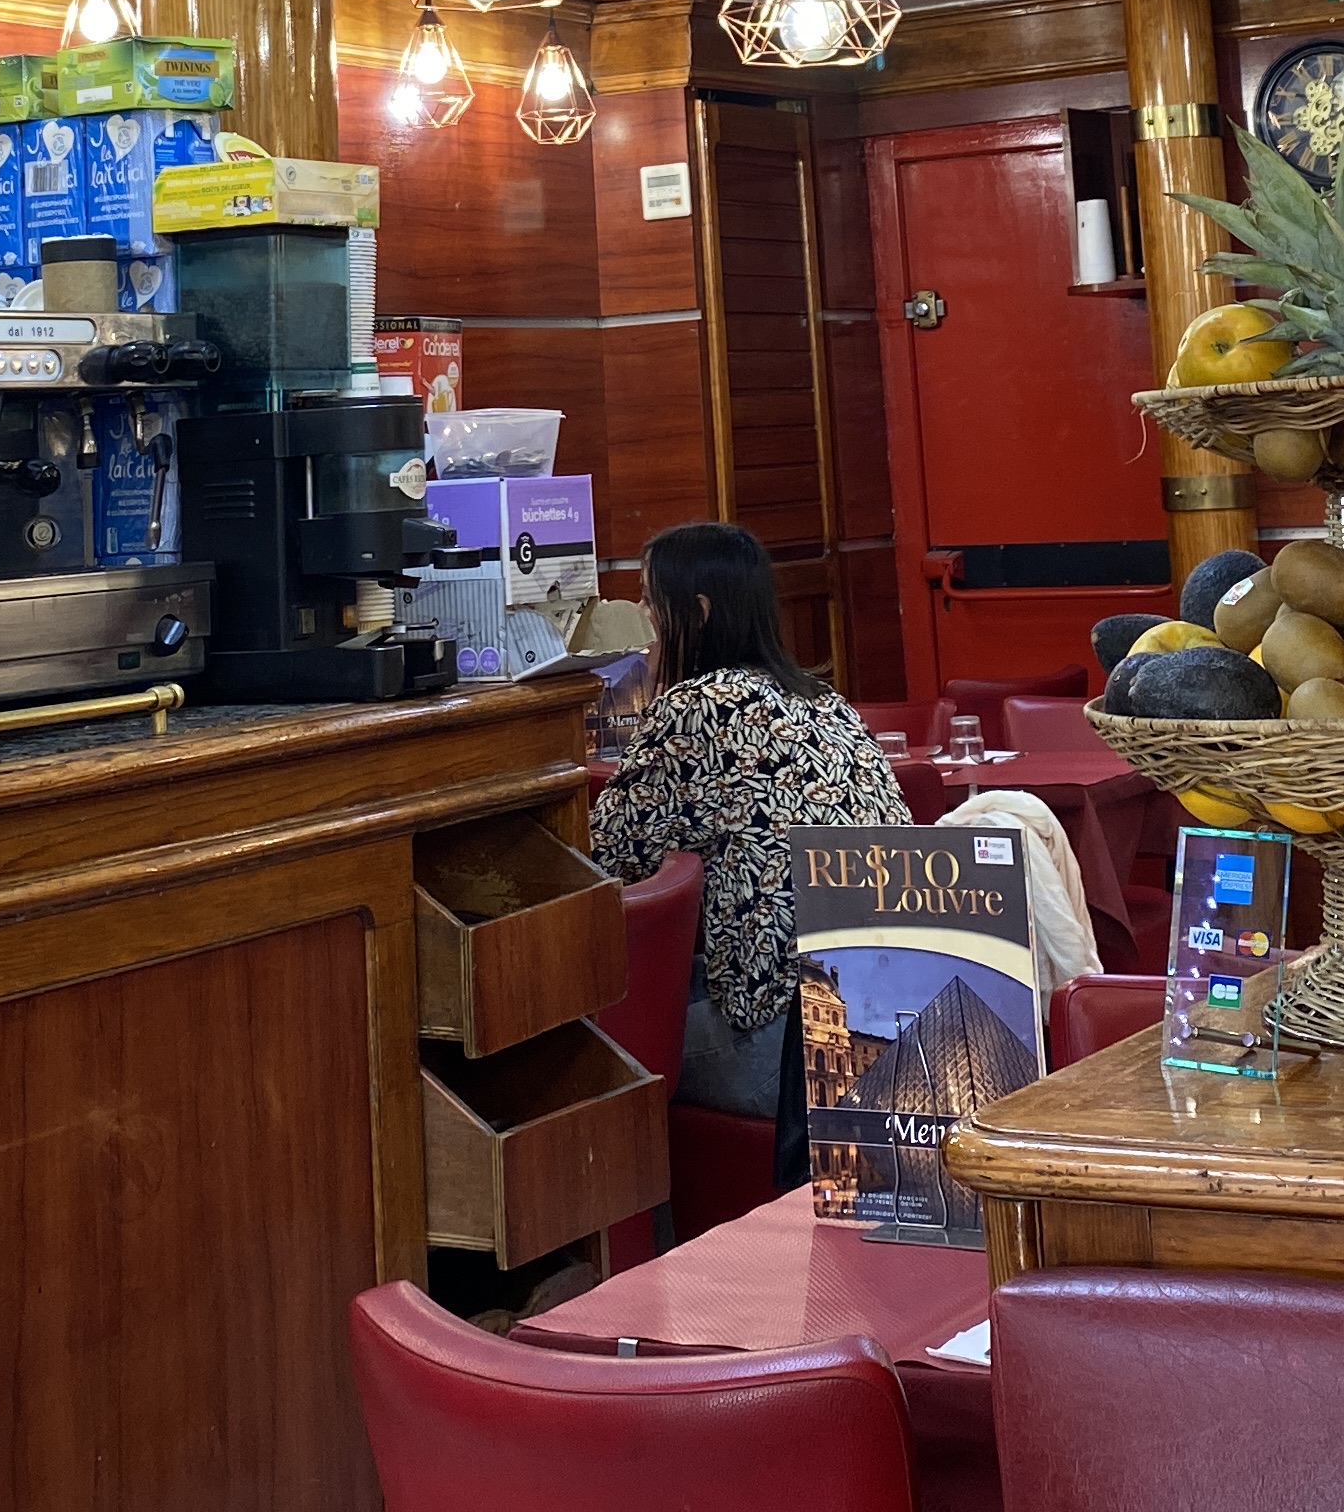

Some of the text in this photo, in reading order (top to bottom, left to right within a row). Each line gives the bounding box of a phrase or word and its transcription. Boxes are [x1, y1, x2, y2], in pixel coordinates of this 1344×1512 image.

[164, 61, 212, 74] TWININGS
[91, 161, 114, 188] lait
[116, 160, 144, 184] d'ici
[8, 326, 23, 338] dal
[31, 326, 54, 338] 1912
[423, 336, 460, 357] Canderel
[108, 453, 132, 481] lait
[567, 506, 574, 520] 4
[574, 509, 580, 523] g
[520, 543, 532, 562] G
[805, 845, 960, 889] RESTO
[1192, 931, 1221, 947] VISA
[1212, 983, 1239, 1001] CB
